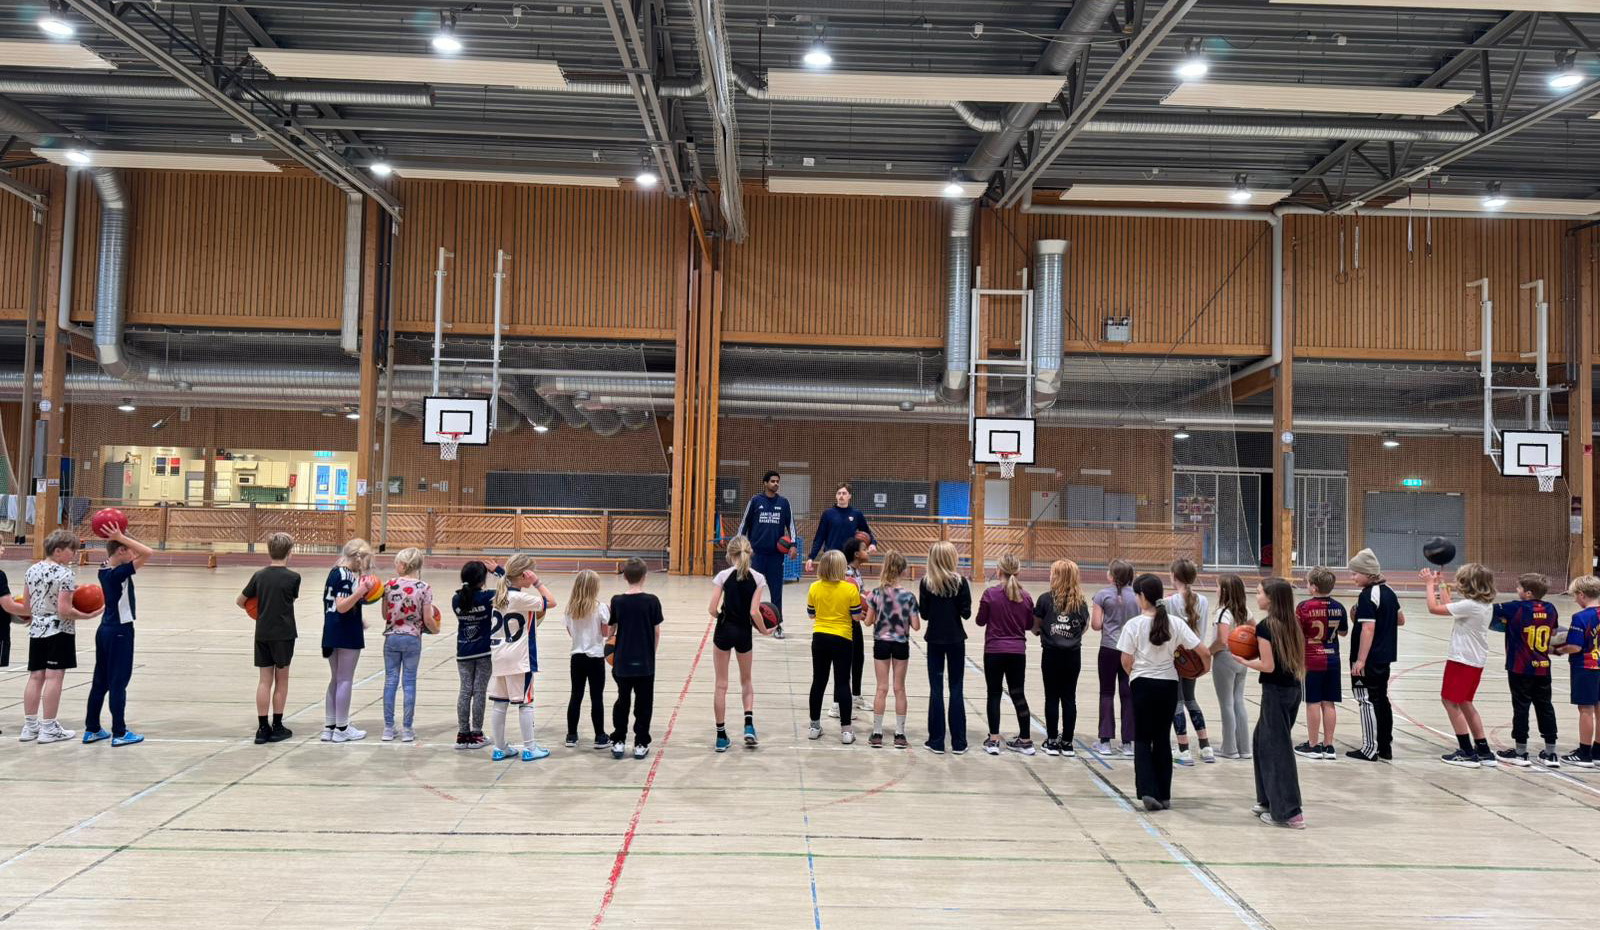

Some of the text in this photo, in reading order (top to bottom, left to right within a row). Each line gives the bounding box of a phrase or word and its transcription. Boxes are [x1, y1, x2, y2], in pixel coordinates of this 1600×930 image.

[490, 610, 525, 646] 20
[1308, 620, 1340, 644] 27
[1523, 625, 1551, 652] 10
